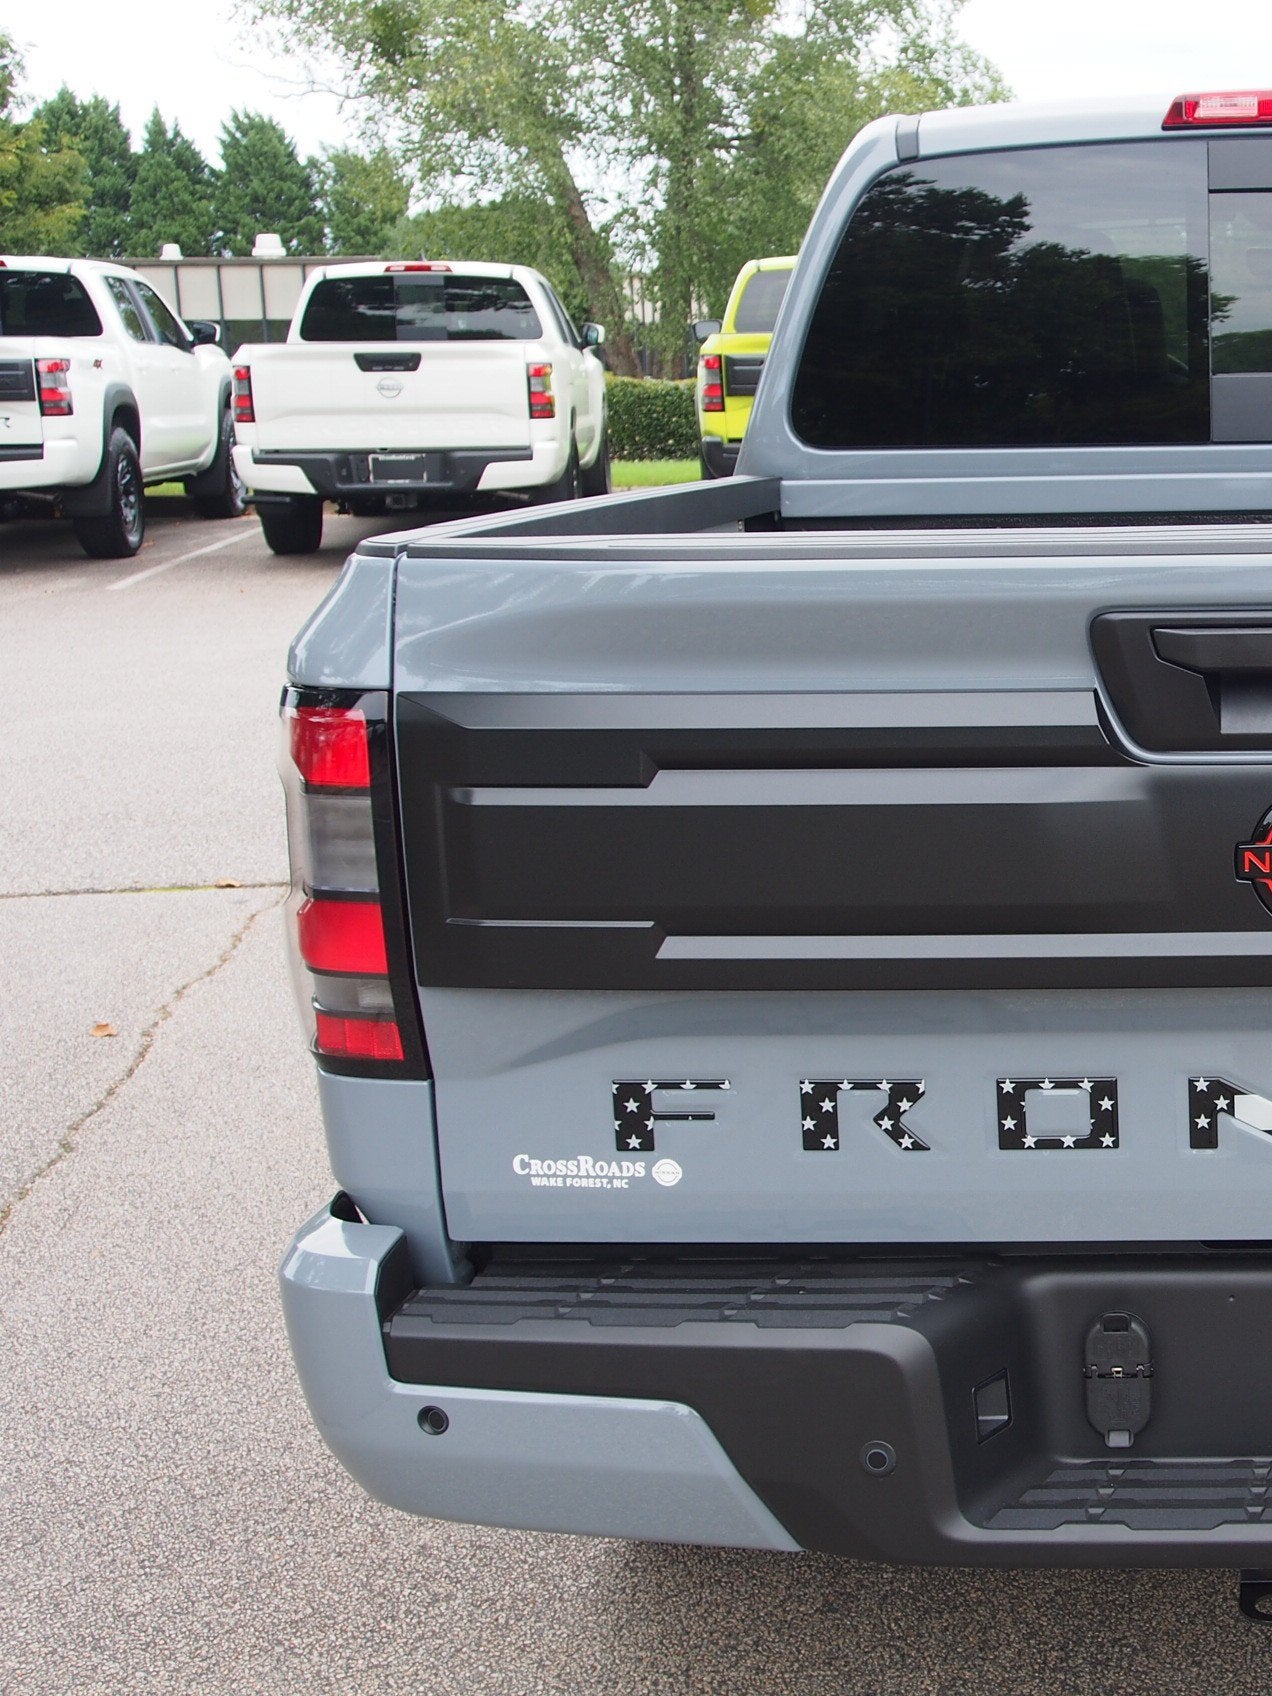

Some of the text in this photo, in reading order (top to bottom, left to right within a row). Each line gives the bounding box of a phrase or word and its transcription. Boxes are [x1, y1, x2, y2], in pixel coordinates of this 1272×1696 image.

[531, 1177, 629, 1189] WAKE FOREST, NC
